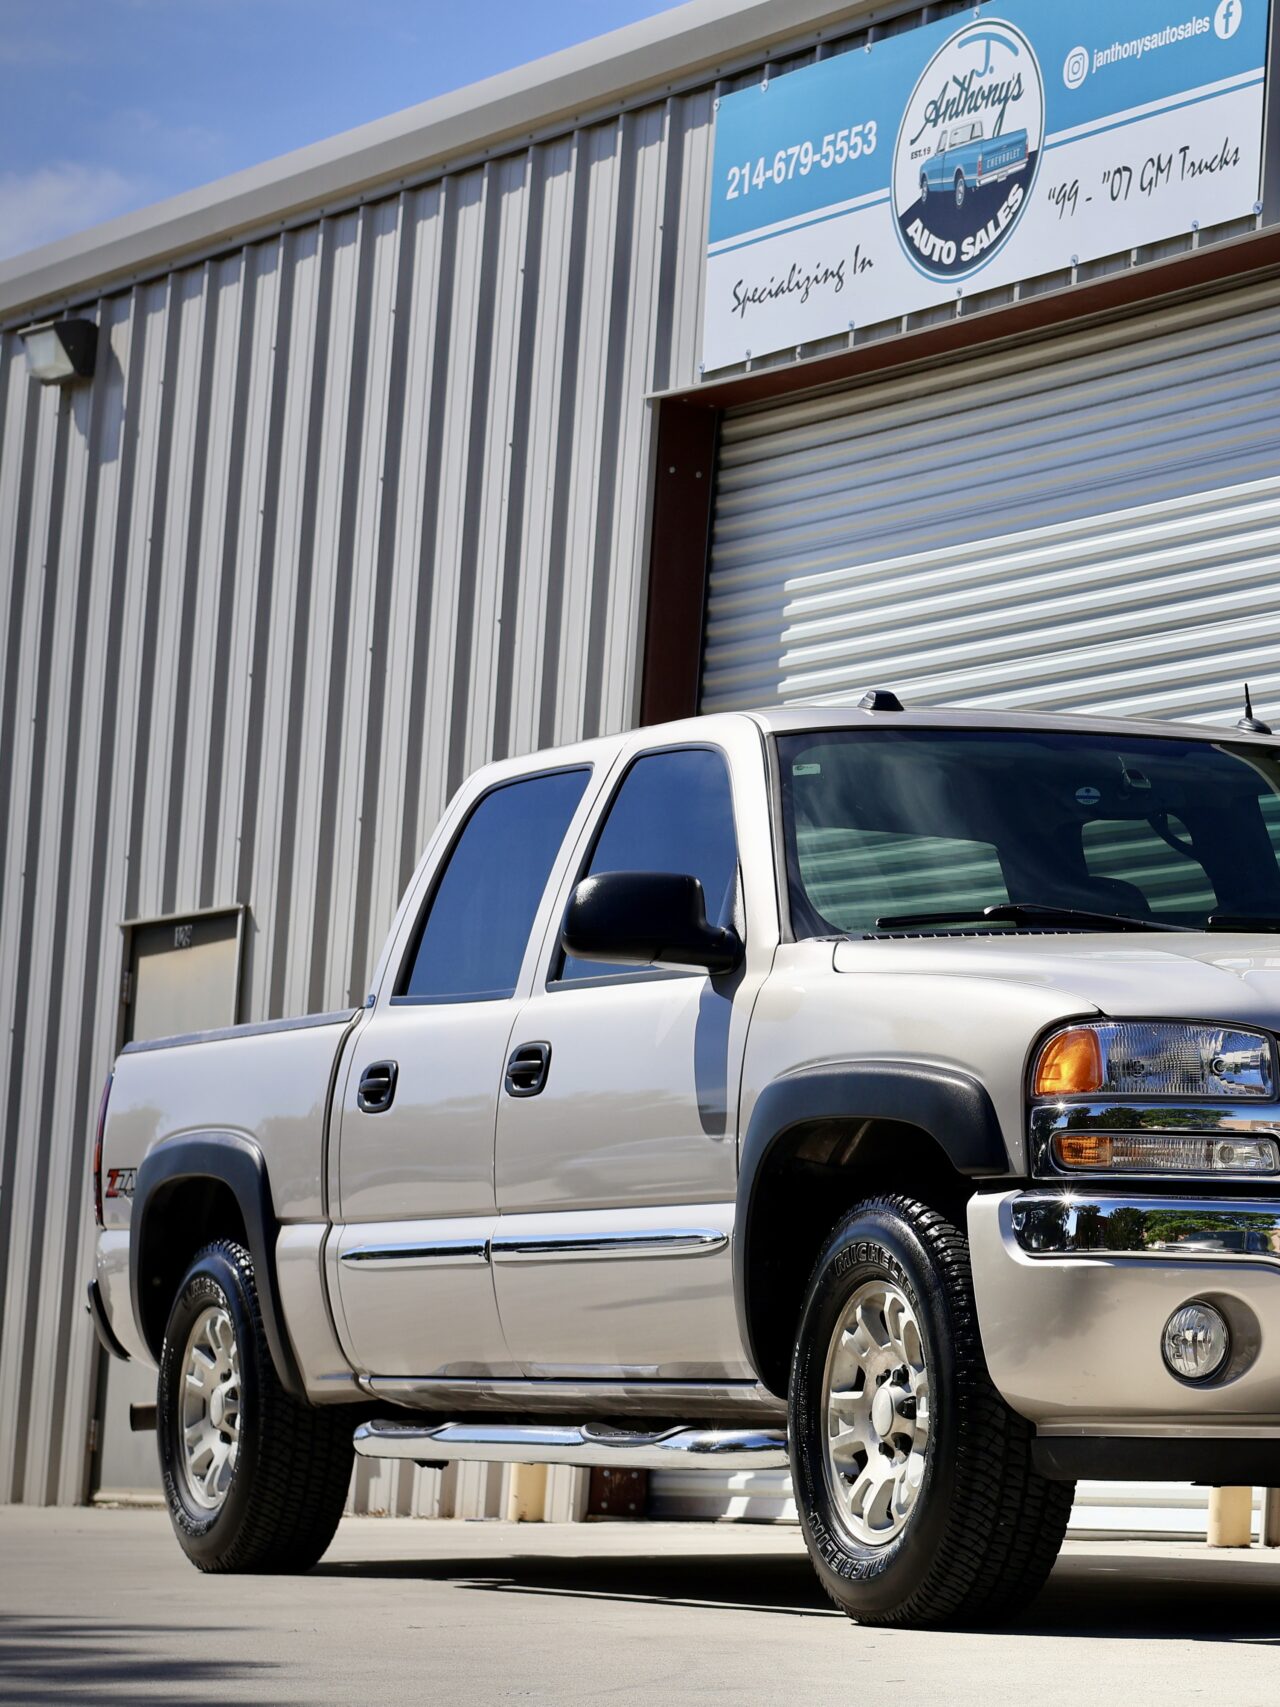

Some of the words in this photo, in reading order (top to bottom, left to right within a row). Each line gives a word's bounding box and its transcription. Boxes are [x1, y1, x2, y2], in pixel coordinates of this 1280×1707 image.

[1092, 16, 1210, 73] janthonysautosales
[910, 68, 1024, 146] Anthony's
[726, 120, 877, 200] 214-679-5553
[1140, 152, 1173, 196] GM
[1179, 136, 1240, 181] Trucks
[906, 218, 956, 265] AUTO
[961, 183, 1024, 262] SALES
[731, 259, 845, 318] Specializing
[853, 244, 874, 275] In
[835, 1242, 917, 1307] MICHELIN
